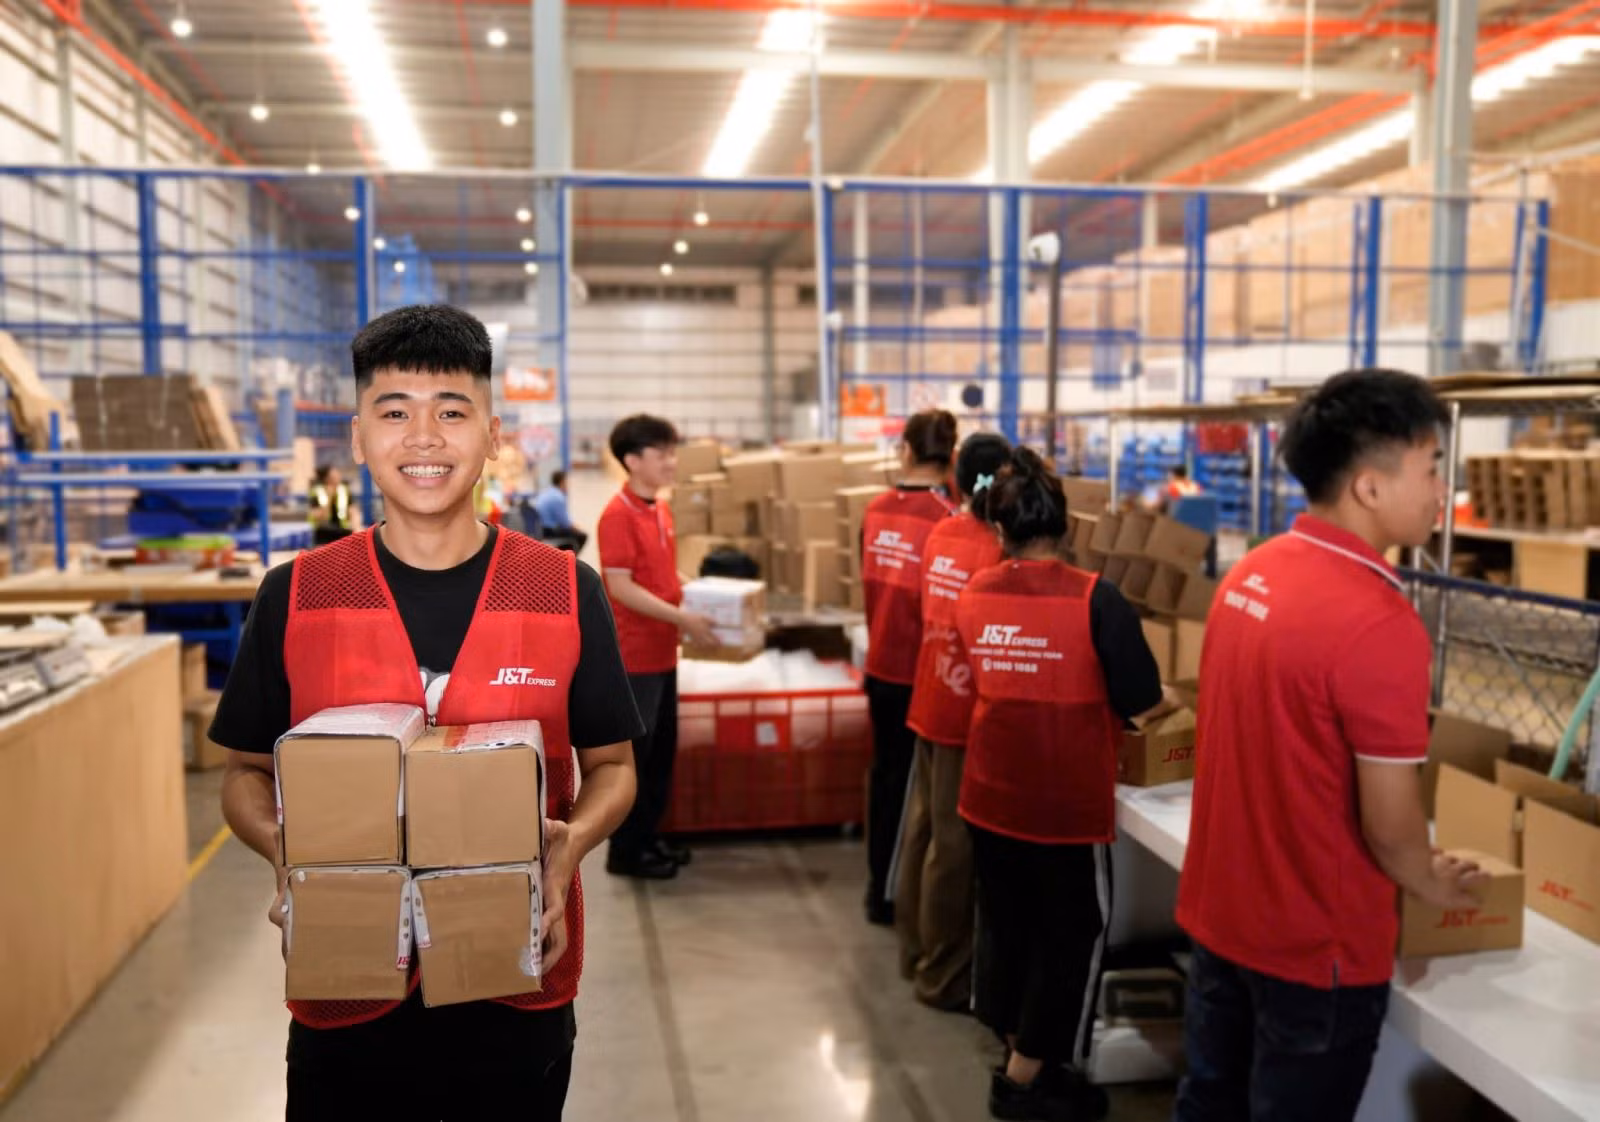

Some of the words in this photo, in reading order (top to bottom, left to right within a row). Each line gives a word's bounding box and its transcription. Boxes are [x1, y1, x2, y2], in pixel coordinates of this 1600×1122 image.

[977, 624, 1022, 645] J&T
[489, 667, 535, 685] J&T
[526, 677, 557, 687] EXPRESS
[1161, 746, 1195, 763] J&T
[1434, 908, 1481, 928] J&T
